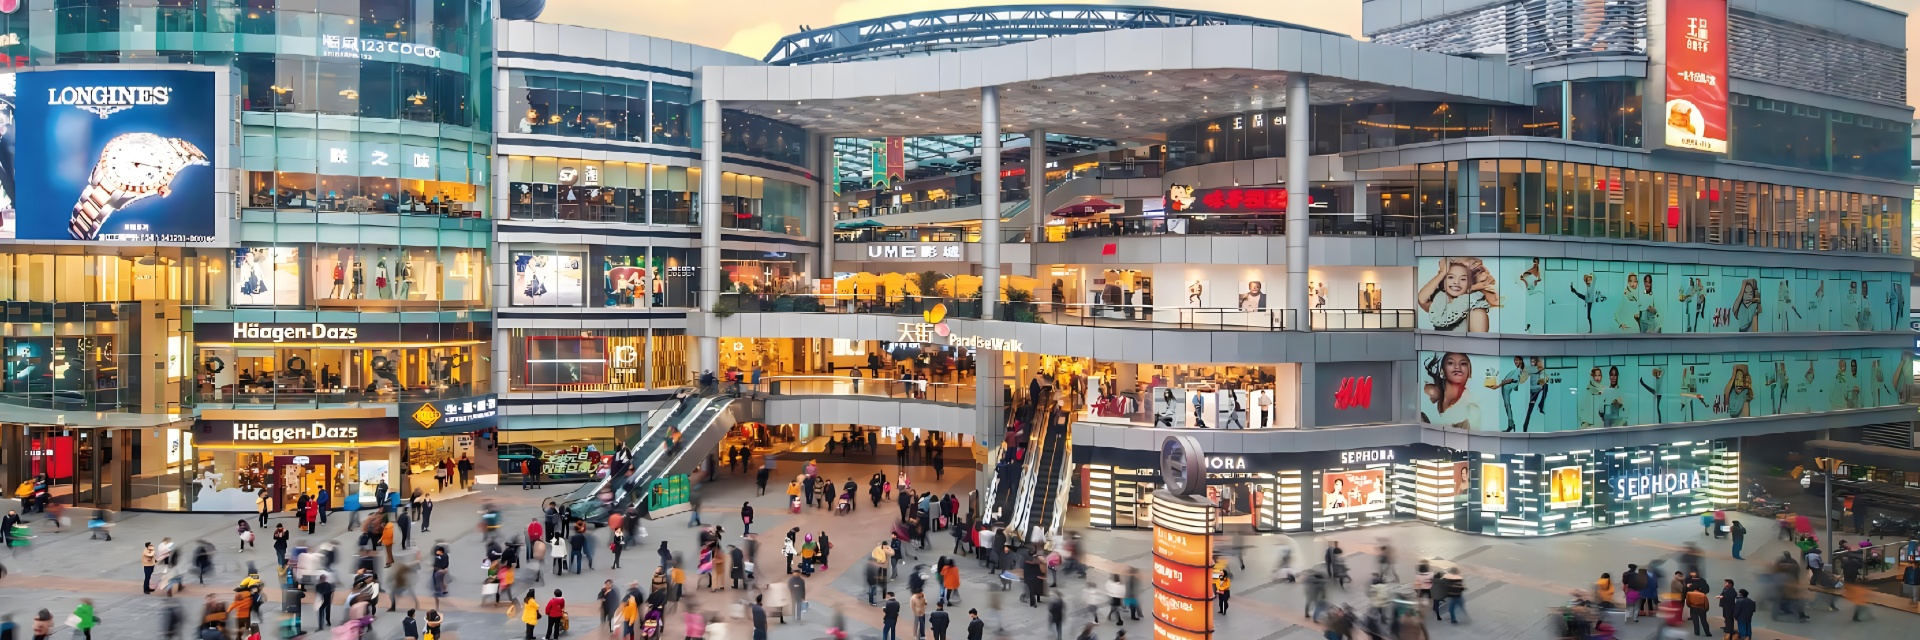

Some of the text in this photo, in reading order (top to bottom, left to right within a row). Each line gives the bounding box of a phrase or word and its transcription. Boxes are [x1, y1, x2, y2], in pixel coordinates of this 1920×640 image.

[47, 86, 170, 105] LONGINES
[868, 245, 917, 258] UME
[897, 322, 935, 344] 天街
[233, 422, 358, 444] Häagen-Dazs
[1617, 469, 1701, 498] SEPHORA
